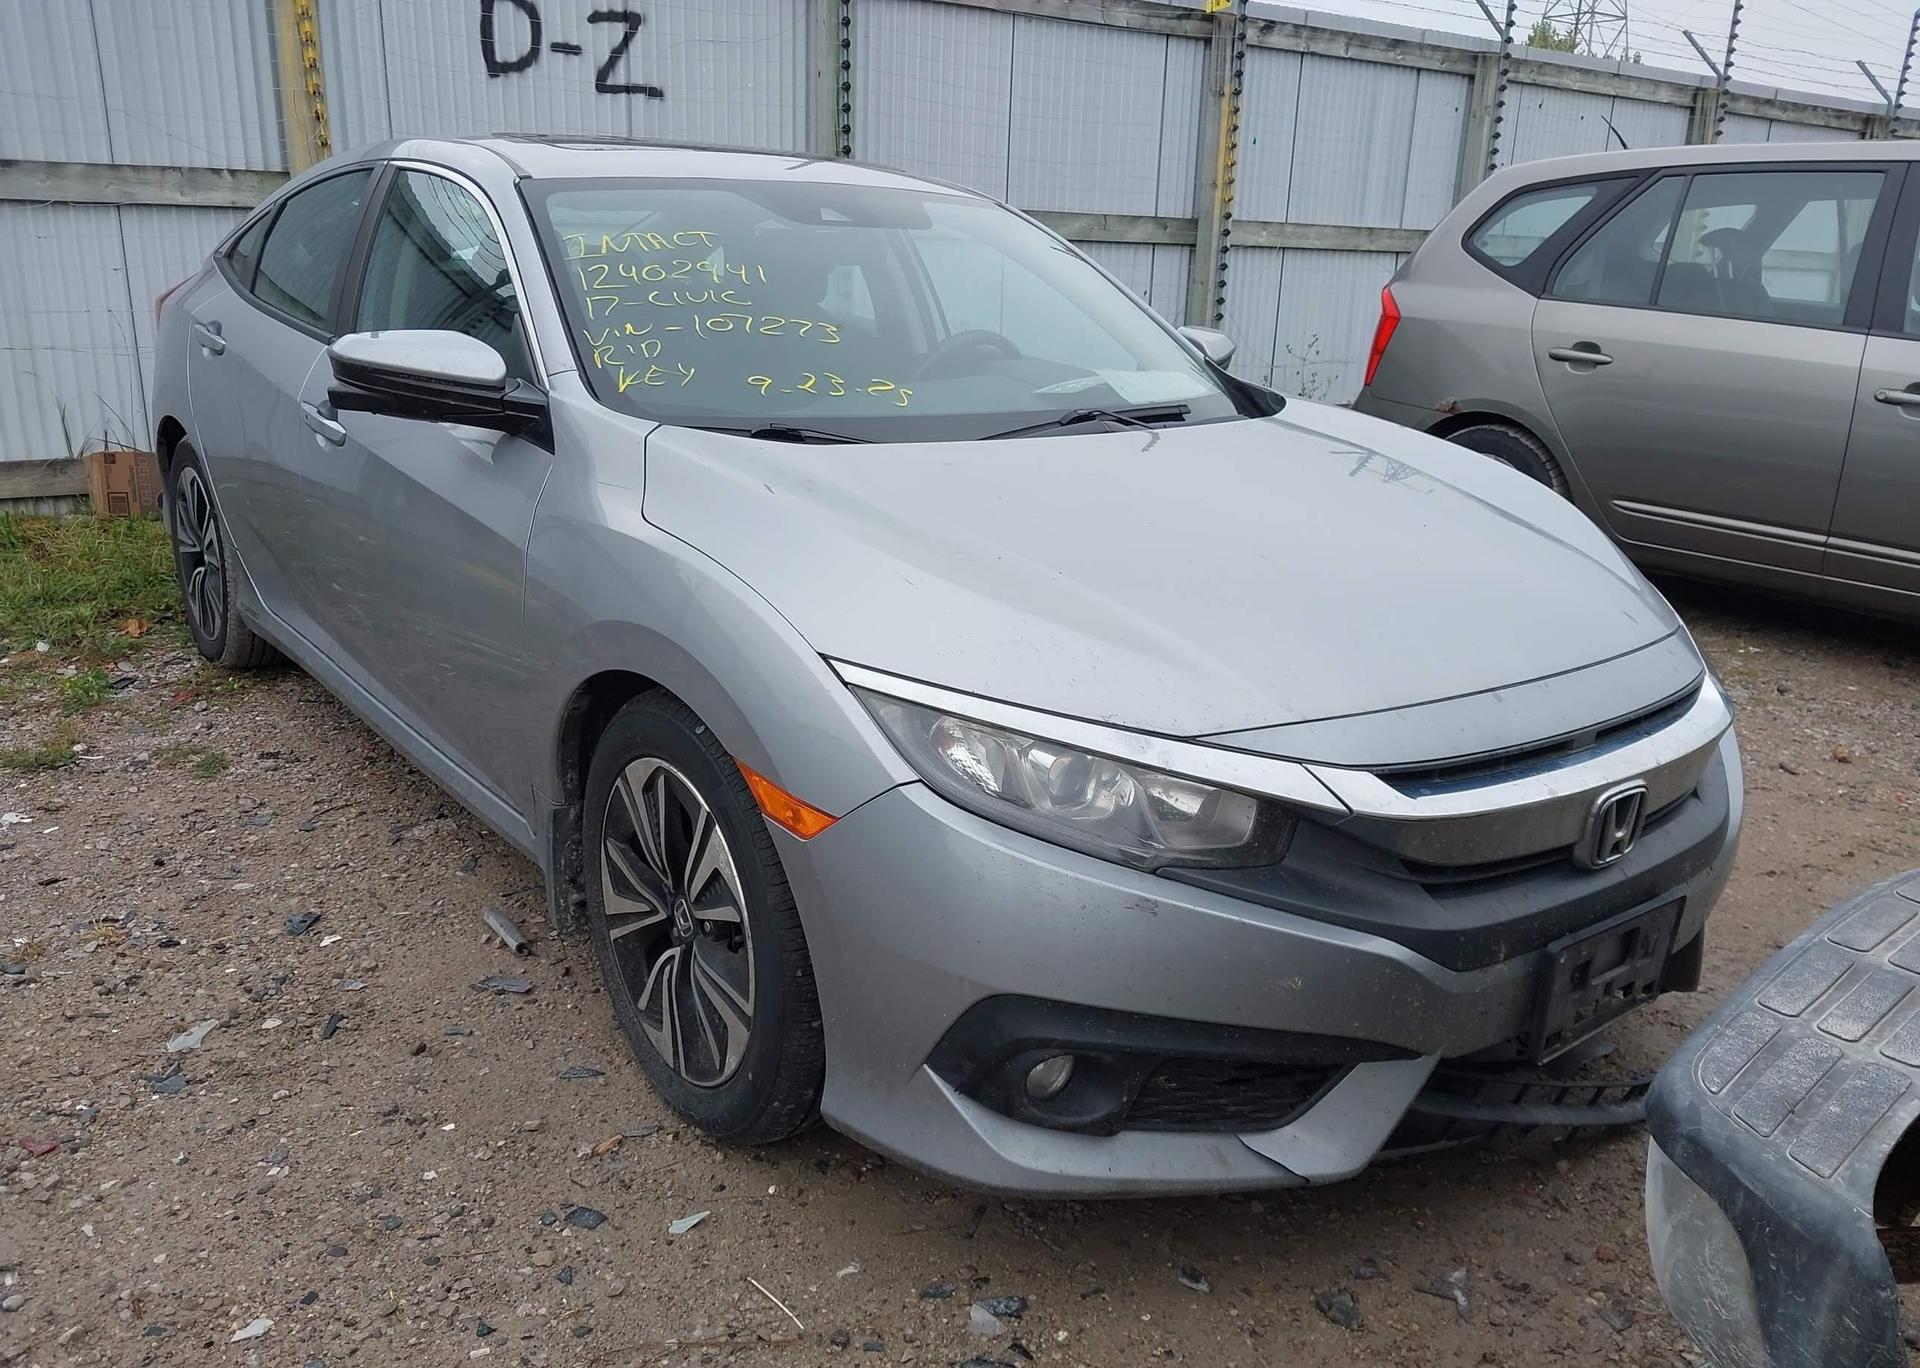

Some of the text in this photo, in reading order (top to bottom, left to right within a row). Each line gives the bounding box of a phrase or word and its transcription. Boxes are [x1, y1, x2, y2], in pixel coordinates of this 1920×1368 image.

[563, 231, 720, 261] INTACT
[577, 260, 767, 292] 12402941
[618, 363, 695, 393] KEY
